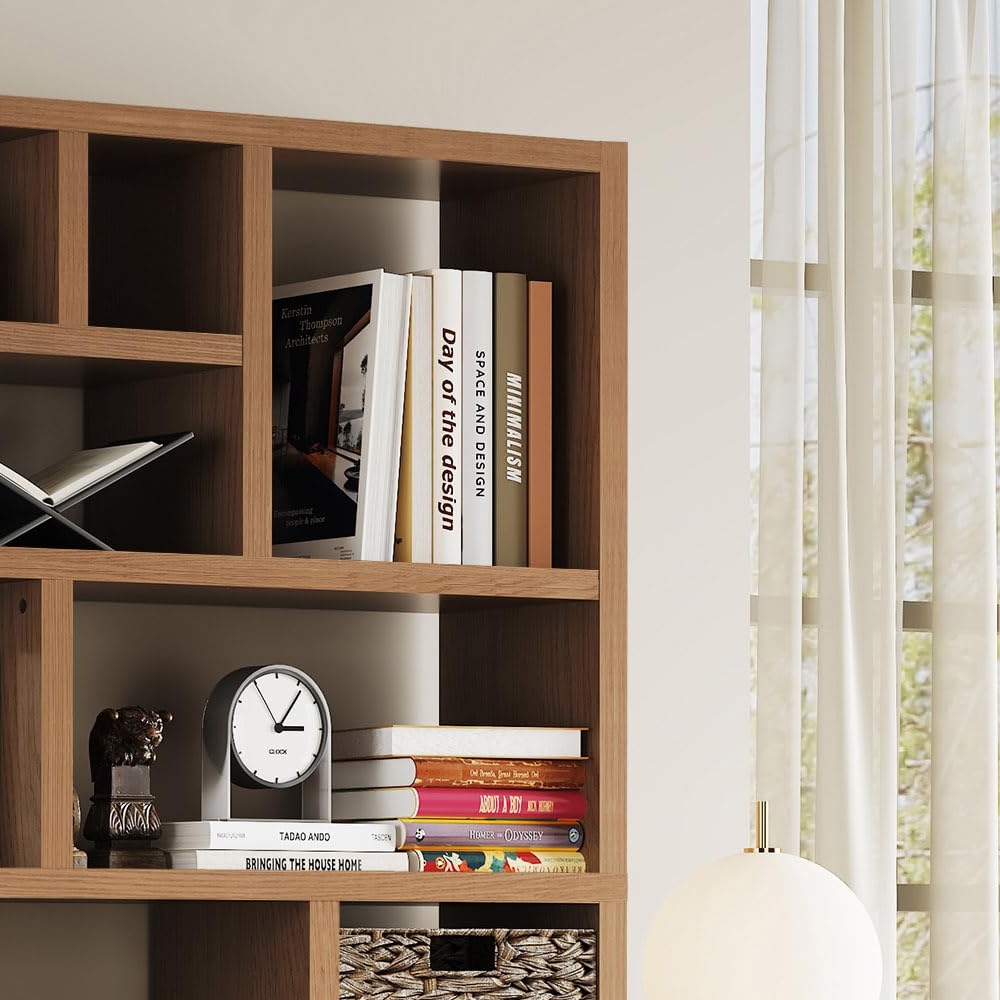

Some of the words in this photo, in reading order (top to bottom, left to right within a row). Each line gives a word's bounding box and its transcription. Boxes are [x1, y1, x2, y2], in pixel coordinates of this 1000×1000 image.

[281, 304, 312, 319] Kerstin
[300, 317, 343, 331] Thompson
[285, 334, 329, 349] Architects
[438, 327, 456, 373] Day
[475, 350, 485, 397] SPACE
[442, 379, 457, 406] of
[442, 410, 456, 448] the
[475, 404, 485, 436] AND
[506, 371, 522, 484] MINIMALISM
[475, 442, 485, 498] DESIGN
[438, 454, 457, 531] design
[479, 795, 500, 813] ABOUT
[502, 795, 507, 813] A
[509, 796, 523, 813] BOY
[279, 831, 306, 841] TADAO
[307, 832, 331, 842] ANDO
[470, 829, 496, 840] HOMER
[504, 828, 544, 842] ODYSSEY
[245, 857, 287, 871] BRINGING
[290, 857, 306, 871] THE
[308, 858, 336, 871] HOUSE
[338, 858, 362, 872] HOME
